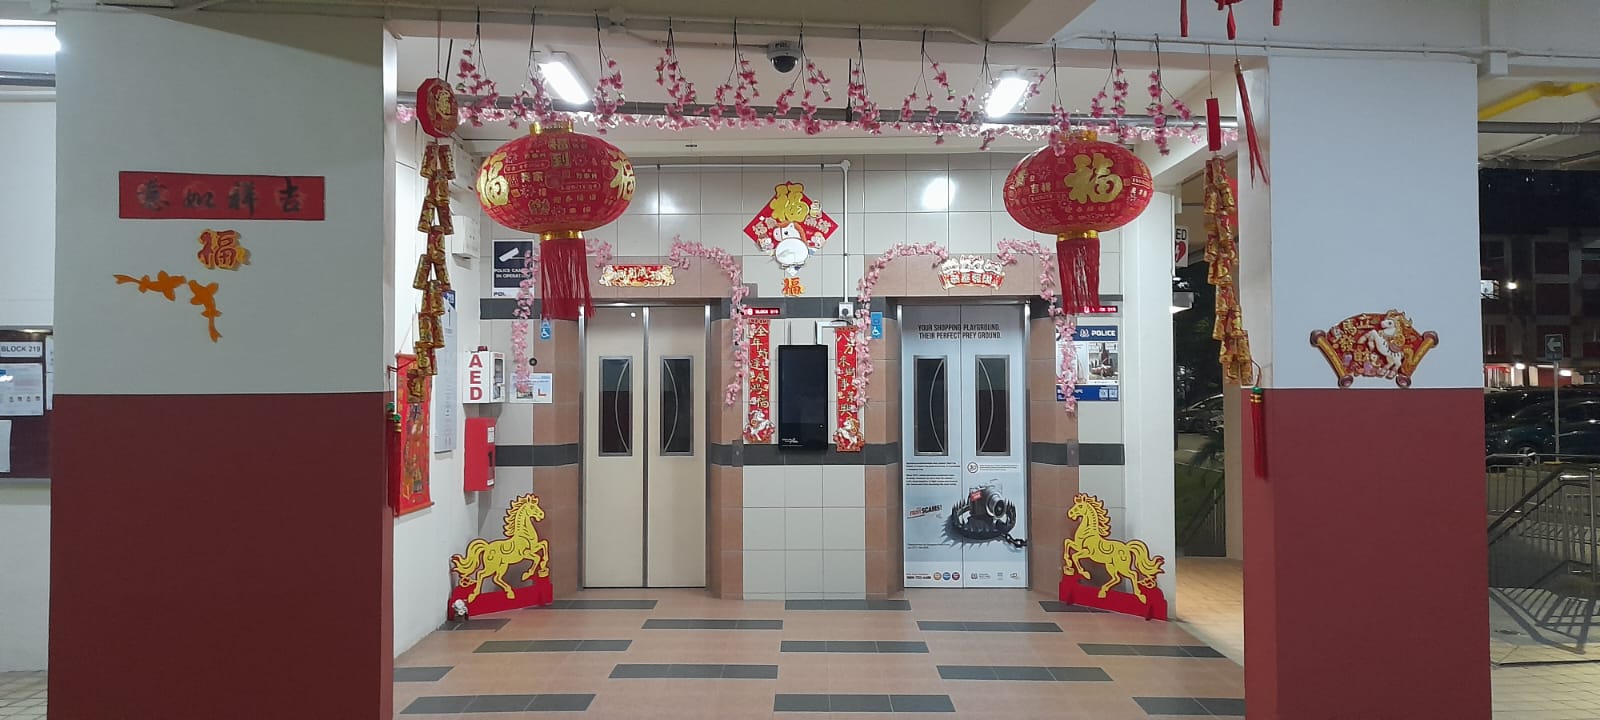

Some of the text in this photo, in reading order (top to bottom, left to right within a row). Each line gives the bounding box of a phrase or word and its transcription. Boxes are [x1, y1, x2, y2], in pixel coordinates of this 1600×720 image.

[1063, 152, 1123, 204] 福
[769, 182, 810, 223] 福
[1175, 228, 1187, 240] ED
[197, 229, 241, 270] 福
[781, 277, 803, 297] 福
[918, 324, 933, 332] YOUR
[934, 324, 961, 332] SHOPPING
[919, 332, 935, 340] THEIR
[936, 332, 960, 340] PERFECT
[1091, 329, 1116, 337] POLICE
[1, 345, 41, 353] BLOCK 219
[469, 354, 483, 401] AED
